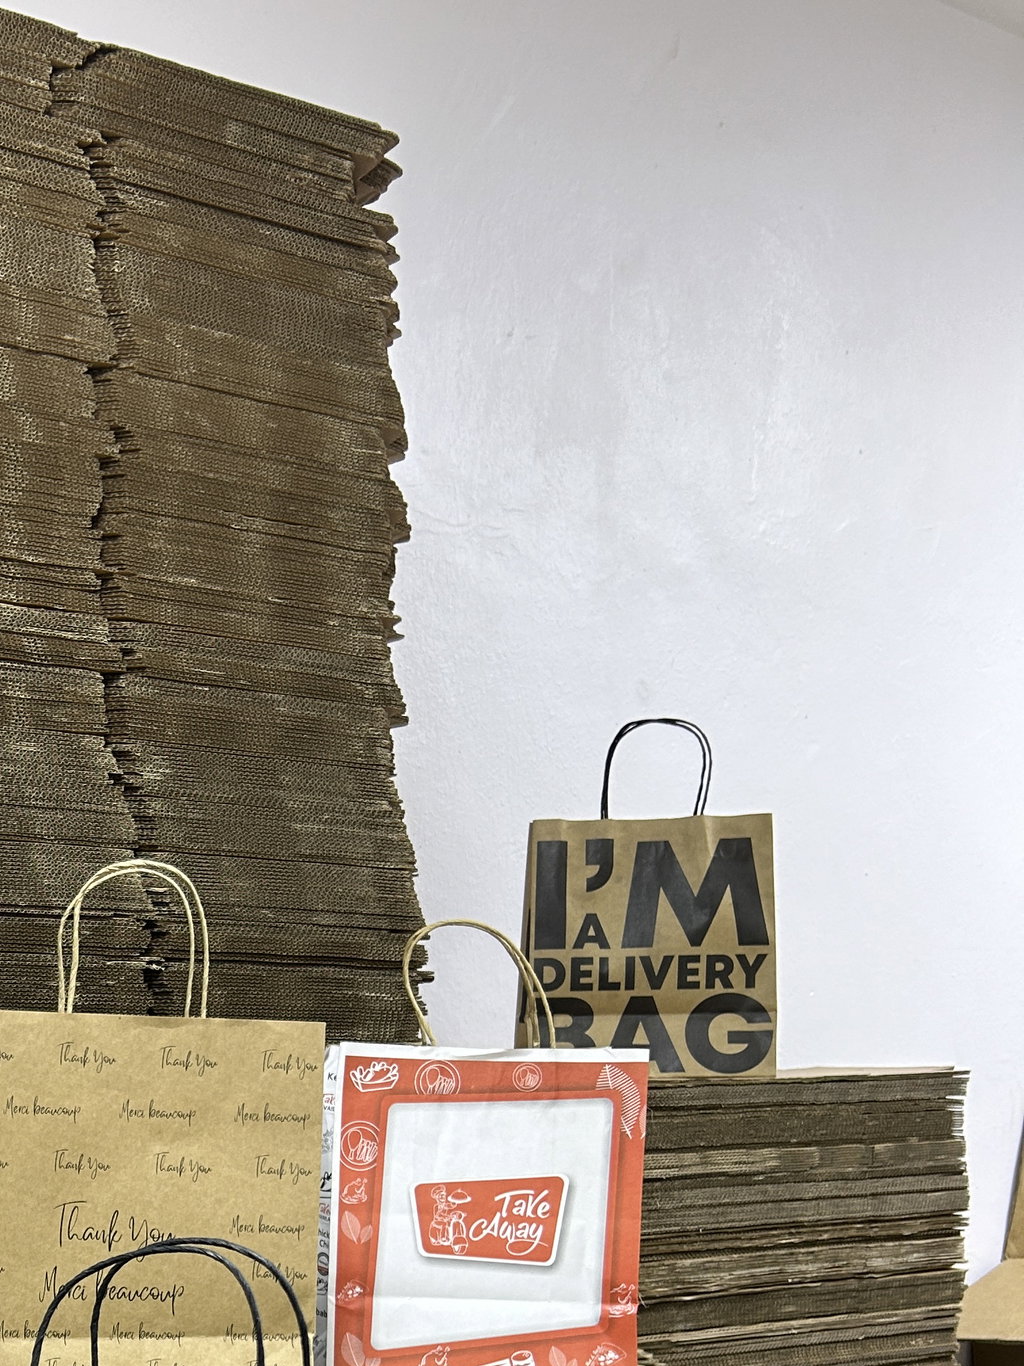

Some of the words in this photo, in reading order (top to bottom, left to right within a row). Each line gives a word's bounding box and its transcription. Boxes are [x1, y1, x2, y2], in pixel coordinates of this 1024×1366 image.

[534, 837, 770, 950] I'M
[572, 912, 611, 950] A
[533, 953, 768, 993] DELIVERY
[532, 992, 774, 1074] BAG
[58, 1041, 90, 1068] Thank
[93, 1050, 117, 1073] You
[160, 1045, 193, 1071] Thank
[195, 1054, 218, 1076] You
[262, 1049, 293, 1074] Thank
[296, 1057, 318, 1080] You
[3, 1096, 29, 1118] Merci
[33, 1096, 81, 1123] beaucoup
[119, 1099, 145, 1122] Merci
[149, 1099, 196, 1127] beaucoup
[234, 1103, 260, 1126] Merci
[264, 1103, 311, 1130] beaucoup
[53, 1149, 85, 1175] Thank
[88, 1157, 111, 1180] You
[154, 1152, 186, 1177] Thank
[189, 1159, 212, 1183] You
[255, 1155, 286, 1180] Thank
[289, 1162, 312, 1185] You
[494, 1189, 550, 1219] Take
[53, 1201, 123, 1252] Thank
[229, 1214, 254, 1238] Merci
[258, 1214, 305, 1241] beaucoup
[469, 1211, 549, 1256] Away
[24, 1319, 71, 1346] beacoup
[110, 1322, 134, 1345] Merci
[138, 1322, 185, 1347] beaucoup
[223, 1323, 248, 1345] Merci
[251, 1325, 299, 1348] baucoup
